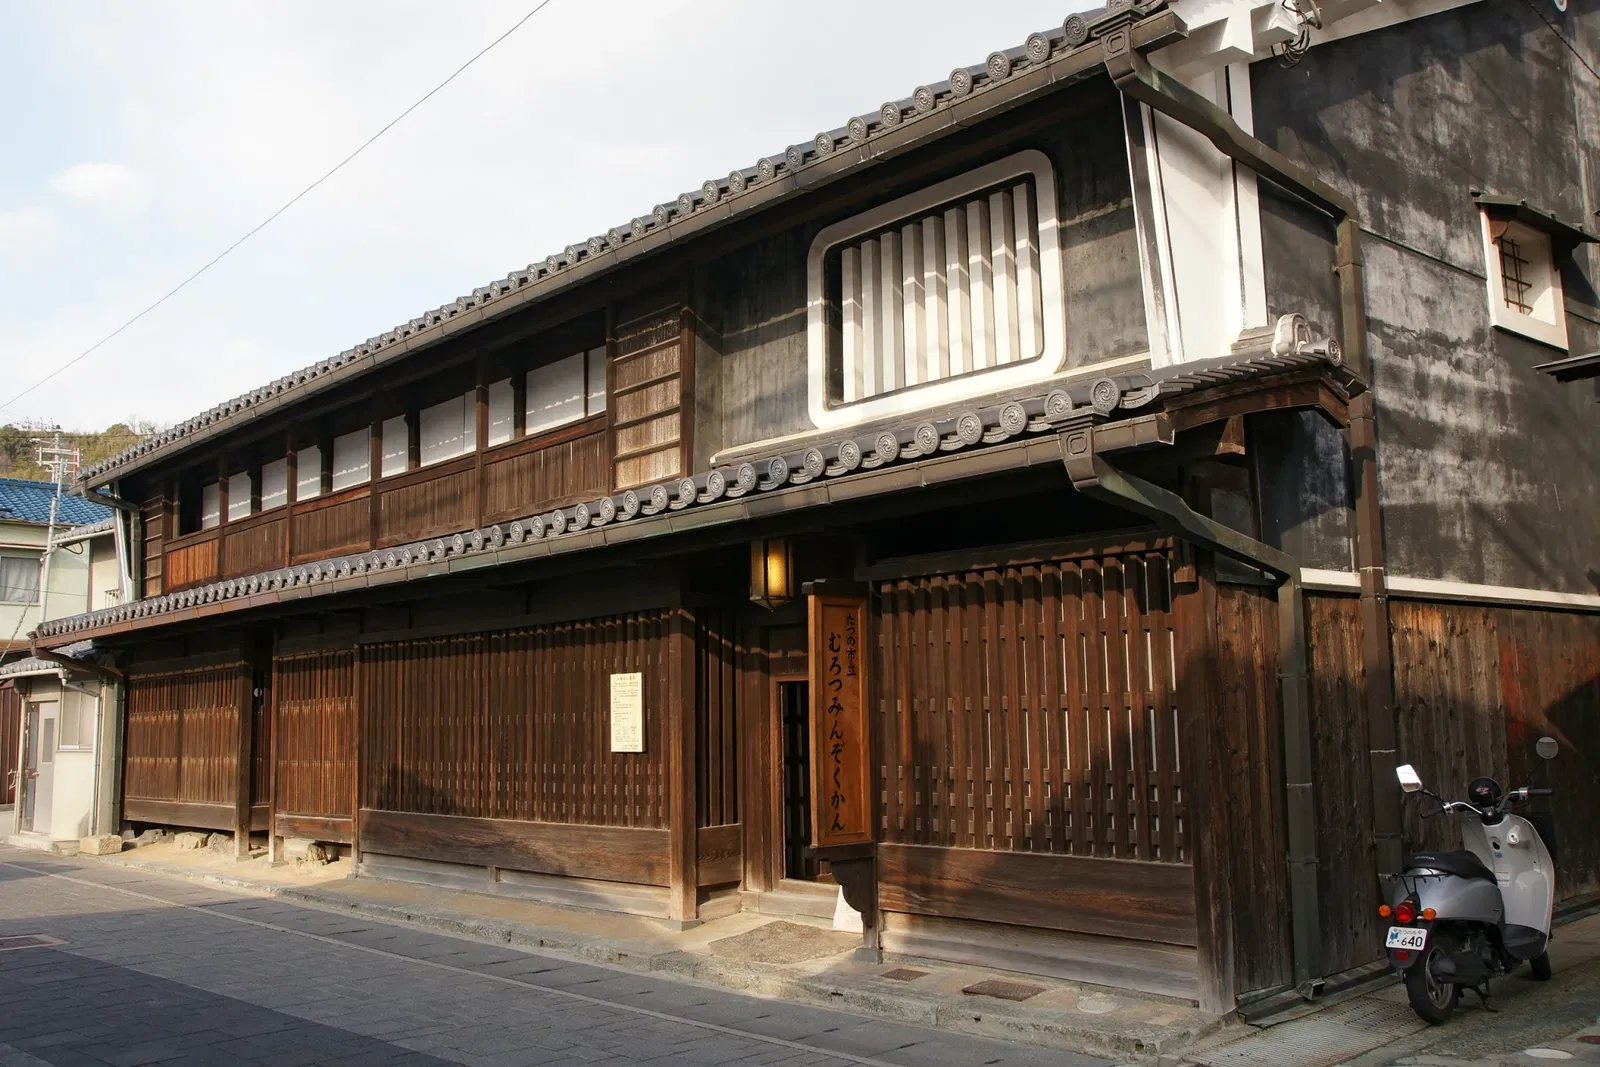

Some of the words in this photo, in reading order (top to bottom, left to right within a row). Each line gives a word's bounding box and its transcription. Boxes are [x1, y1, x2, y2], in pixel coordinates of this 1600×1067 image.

[846, 613, 857, 677] たつの市立
[828, 631, 846, 832] むろつみんぞくかん
